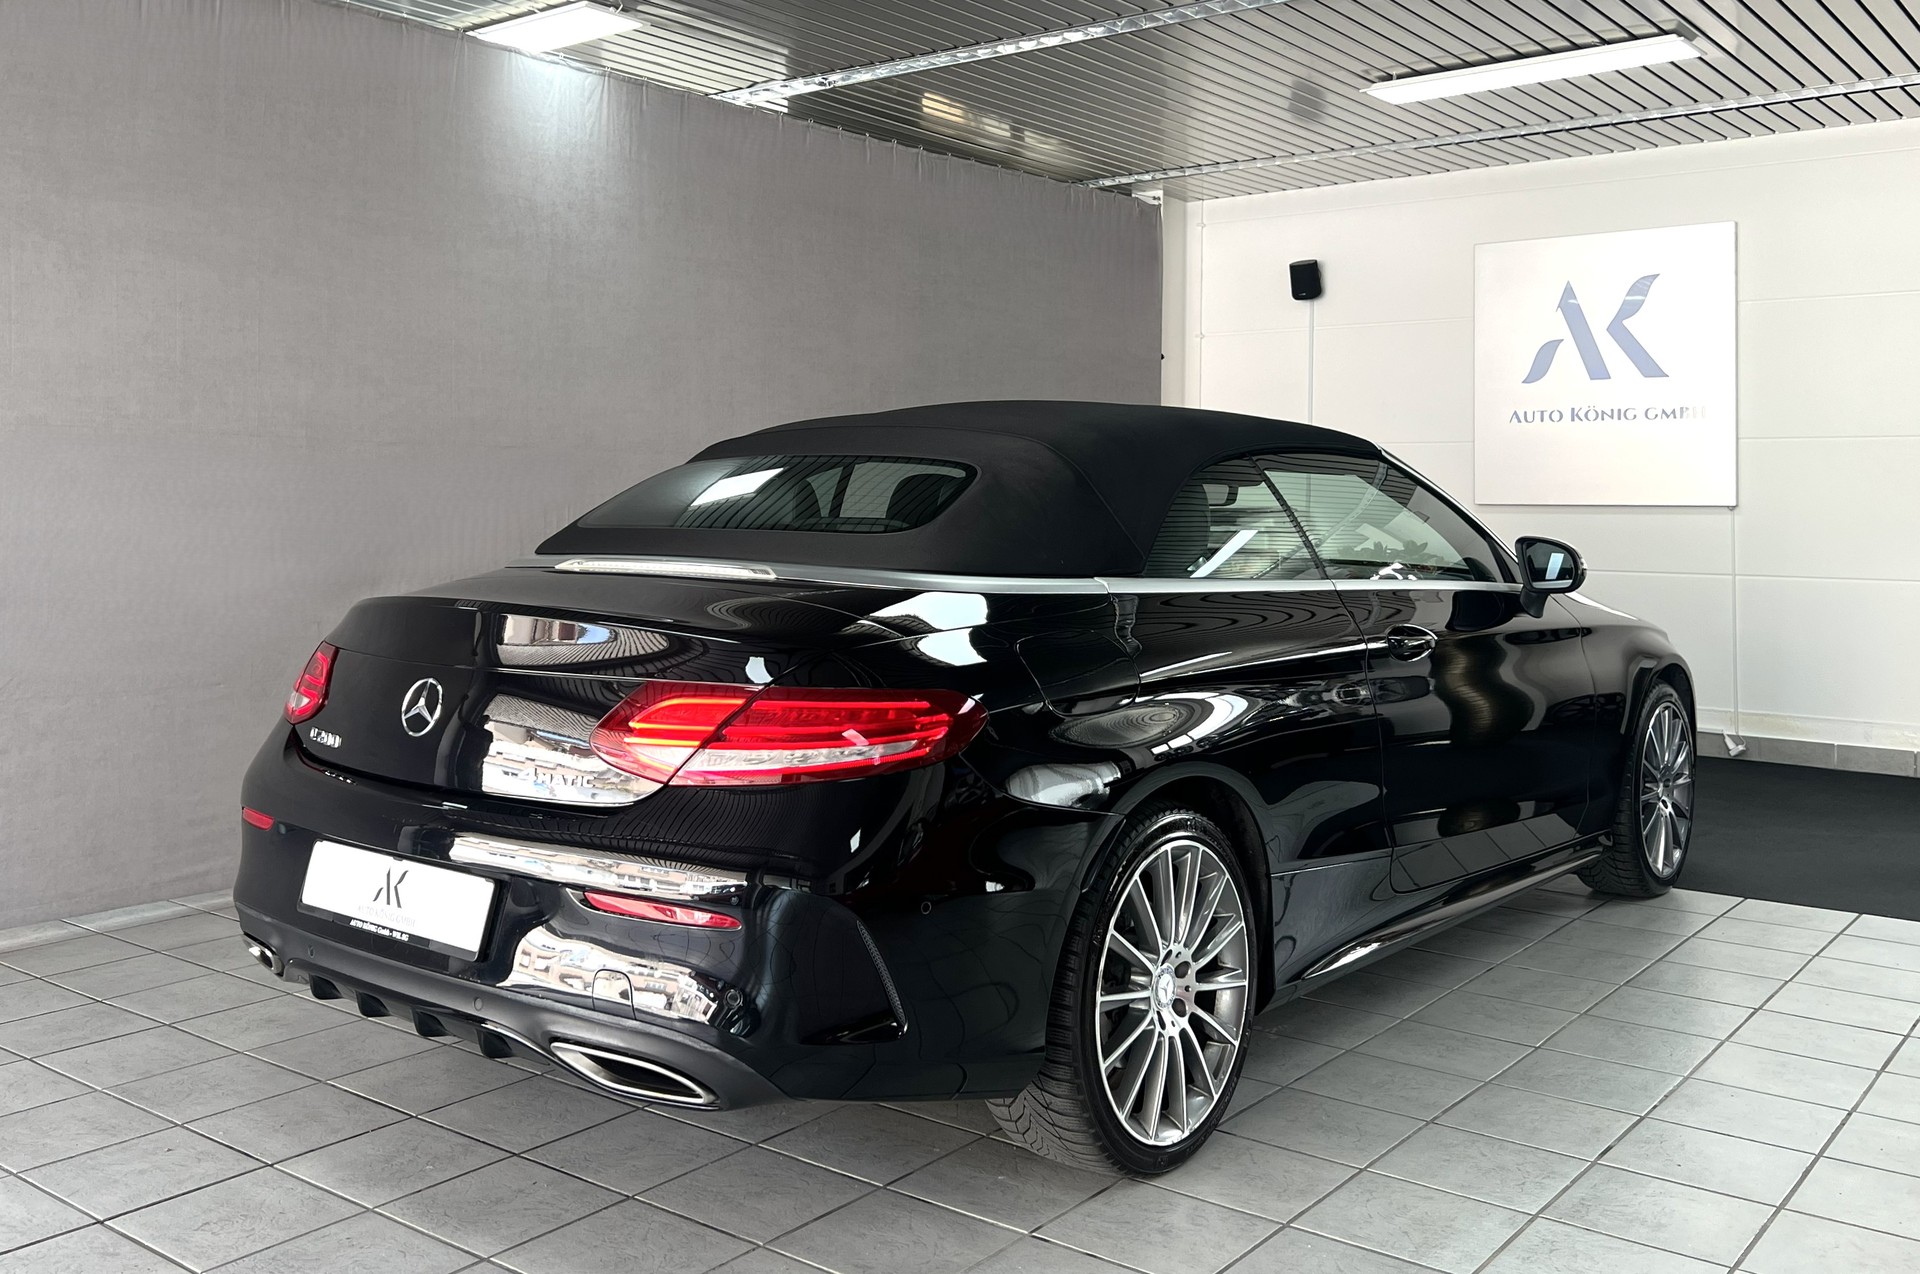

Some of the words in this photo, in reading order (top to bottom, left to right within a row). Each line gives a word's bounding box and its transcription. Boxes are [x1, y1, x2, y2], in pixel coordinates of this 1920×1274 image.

[1509, 408, 1563, 424] AUTO
[1570, 404, 1637, 423] KÖNIG
[519, 767, 596, 788] 4MATIC
